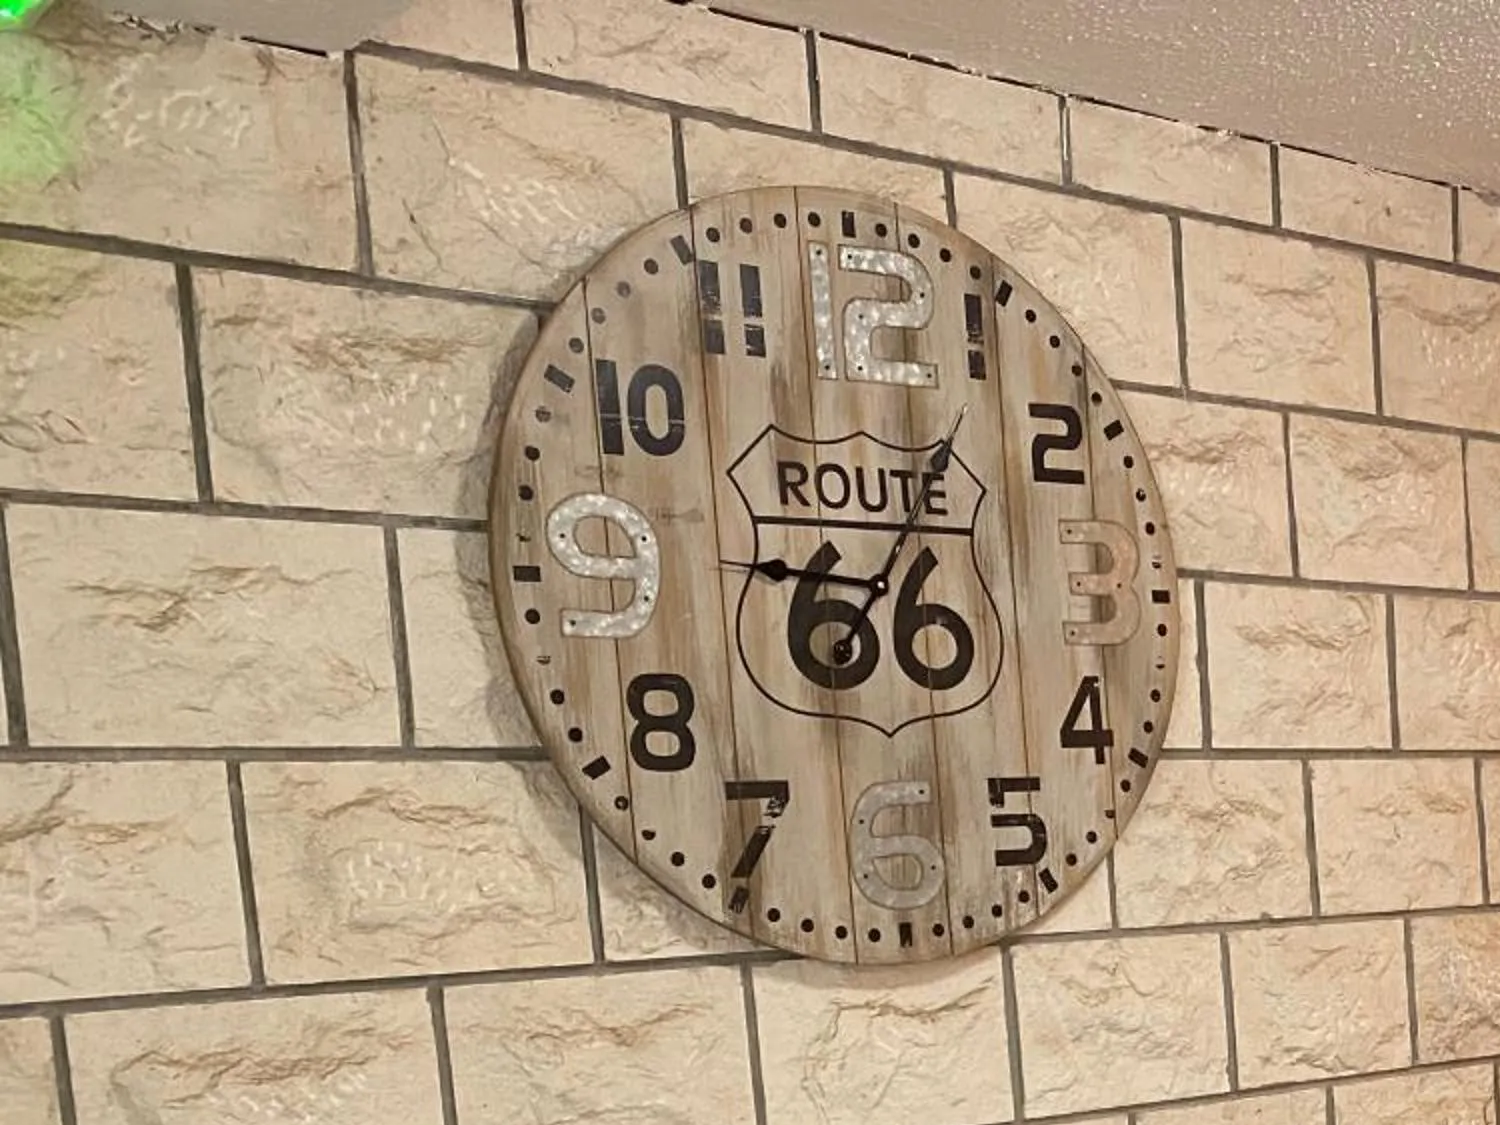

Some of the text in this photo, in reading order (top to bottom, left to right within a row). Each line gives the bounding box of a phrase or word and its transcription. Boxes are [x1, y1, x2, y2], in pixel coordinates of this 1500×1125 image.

[699, 260, 767, 358] 11
[808, 240, 939, 389] 12
[964, 293, 987, 381] 1
[595, 358, 687, 457] 10
[1028, 403, 1086, 485] 2
[776, 459, 950, 517] ROUTE
[545, 493, 661, 640] 9
[787, 540, 975, 691] 66
[1058, 519, 1142, 646] 3
[626, 673, 697, 772] 8
[1058, 675, 1114, 765] 4
[723, 779, 790, 880] 7
[851, 780, 946, 910] 6
[987, 776, 1049, 868] 5
